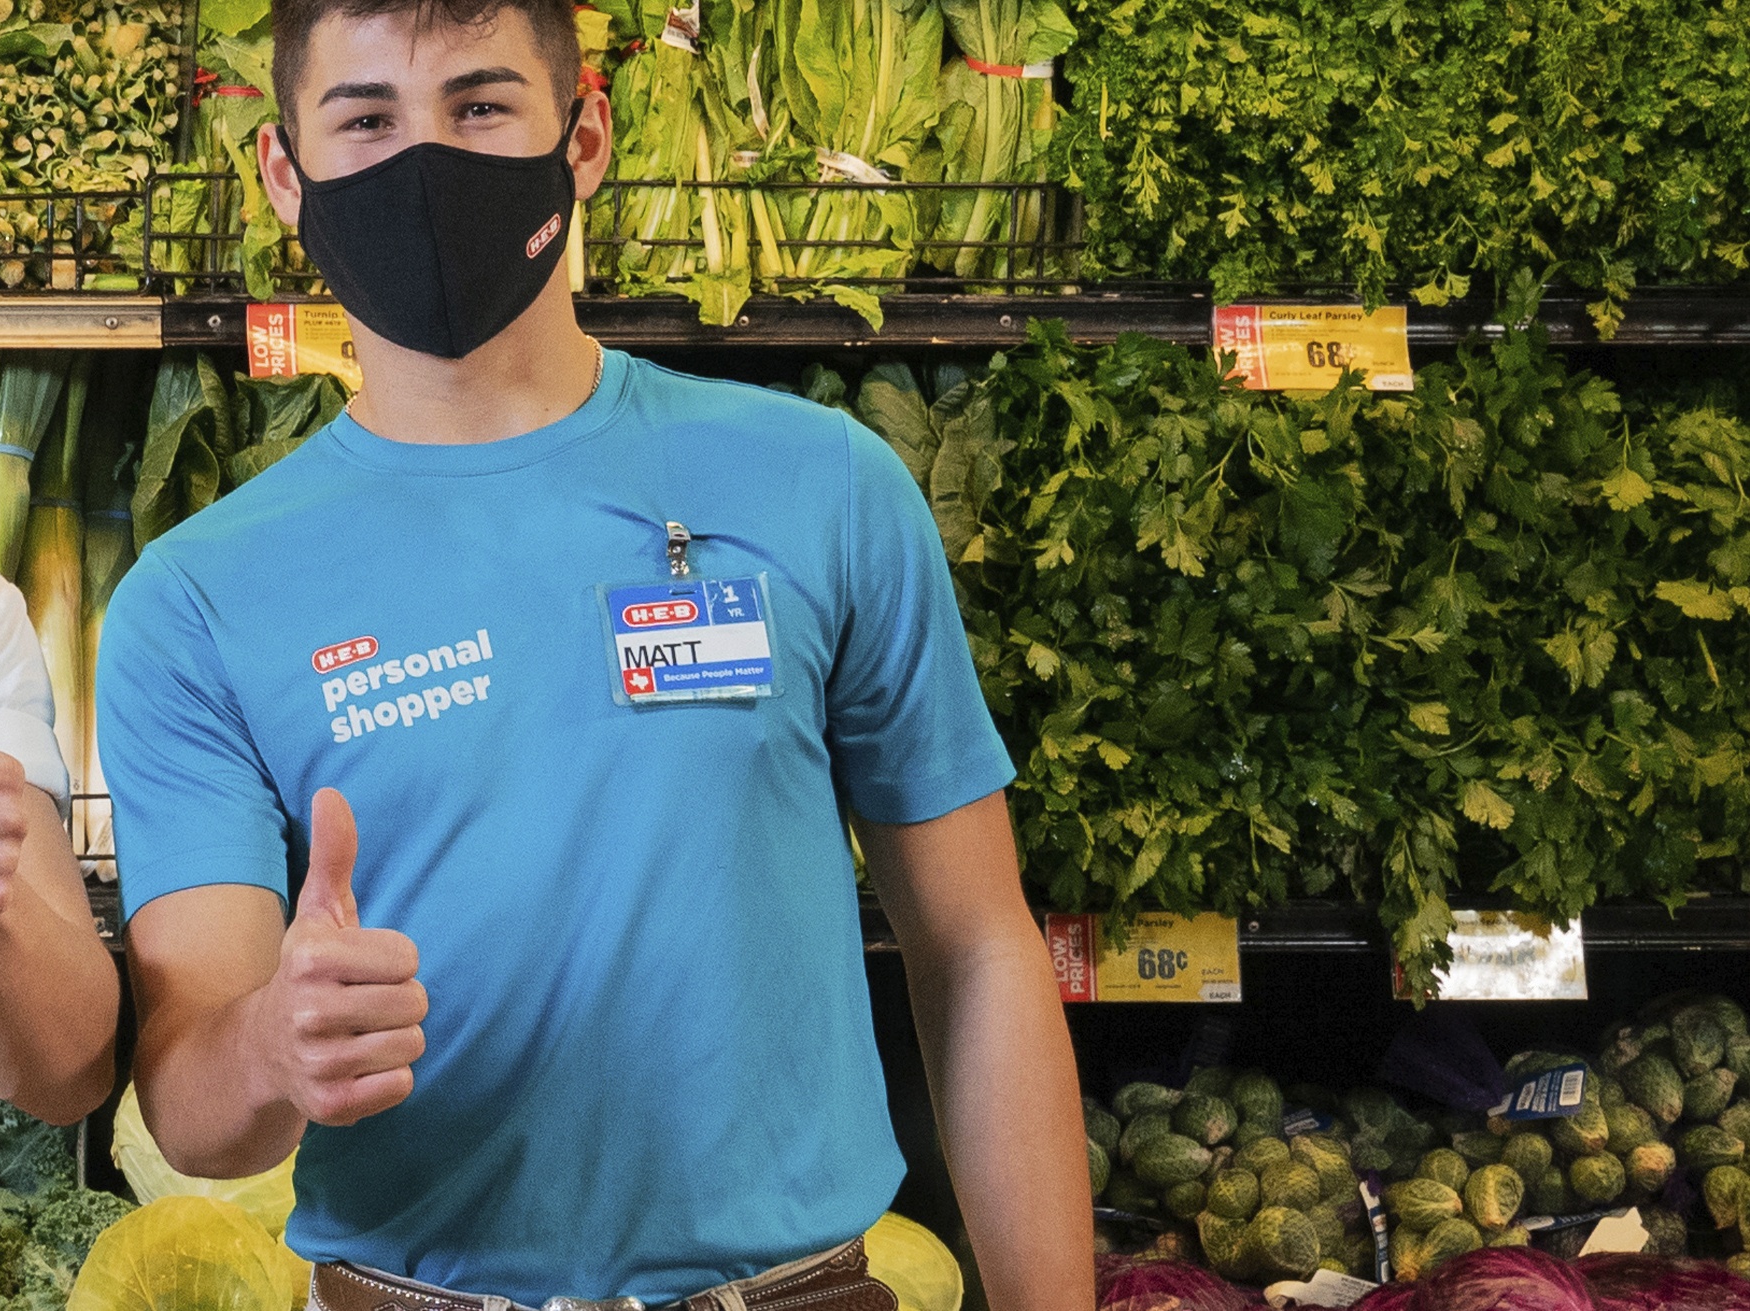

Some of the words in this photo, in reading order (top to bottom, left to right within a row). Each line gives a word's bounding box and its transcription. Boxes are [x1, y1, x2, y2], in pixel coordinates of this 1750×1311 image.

[304, 310, 339, 319] Turnip
[1269, 311, 1296, 320] Curly
[1300, 311, 1322, 320] Leaf
[1325, 311, 1363, 321] Parsley
[251, 325, 270, 368] LOW
[723, 585, 739, 603] 1
[624, 640, 702, 669] MATT
[321, 628, 494, 713] personal
[663, 670, 700, 682] Because
[702, 668, 734, 679] People
[735, 666, 765, 676] Matter
[330, 674, 492, 744] shopper
[1138, 918, 1175, 928] Parsley
[1053, 936, 1069, 982] LOW
[1068, 923, 1085, 994] PRICES
[1138, 948, 1188, 980] 68¢
